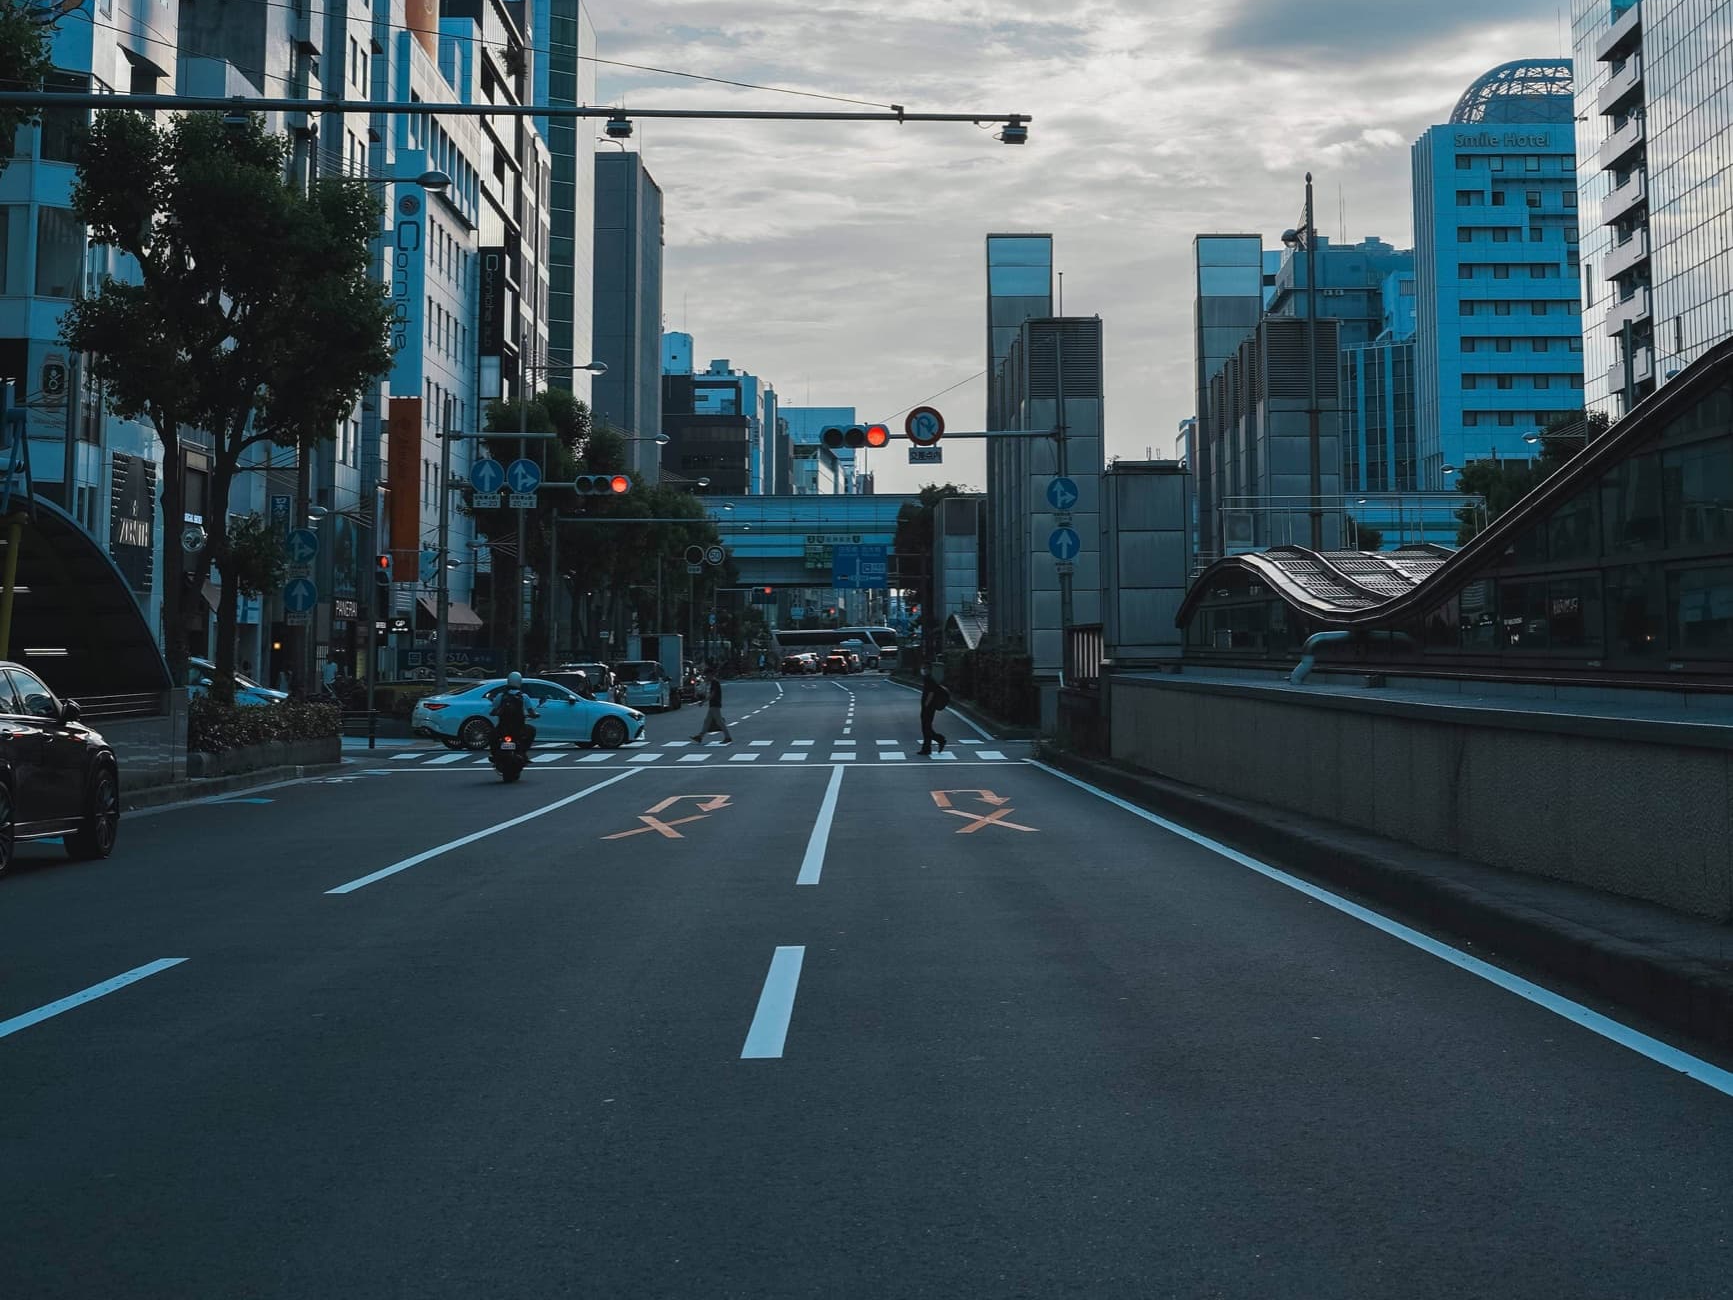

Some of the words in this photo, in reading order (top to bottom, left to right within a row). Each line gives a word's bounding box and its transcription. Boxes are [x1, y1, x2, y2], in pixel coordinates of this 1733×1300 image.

[1455, 132, 1498, 147] Smile
[1504, 132, 1550, 147] Hotel
[394, 220, 420, 350] Corniche
